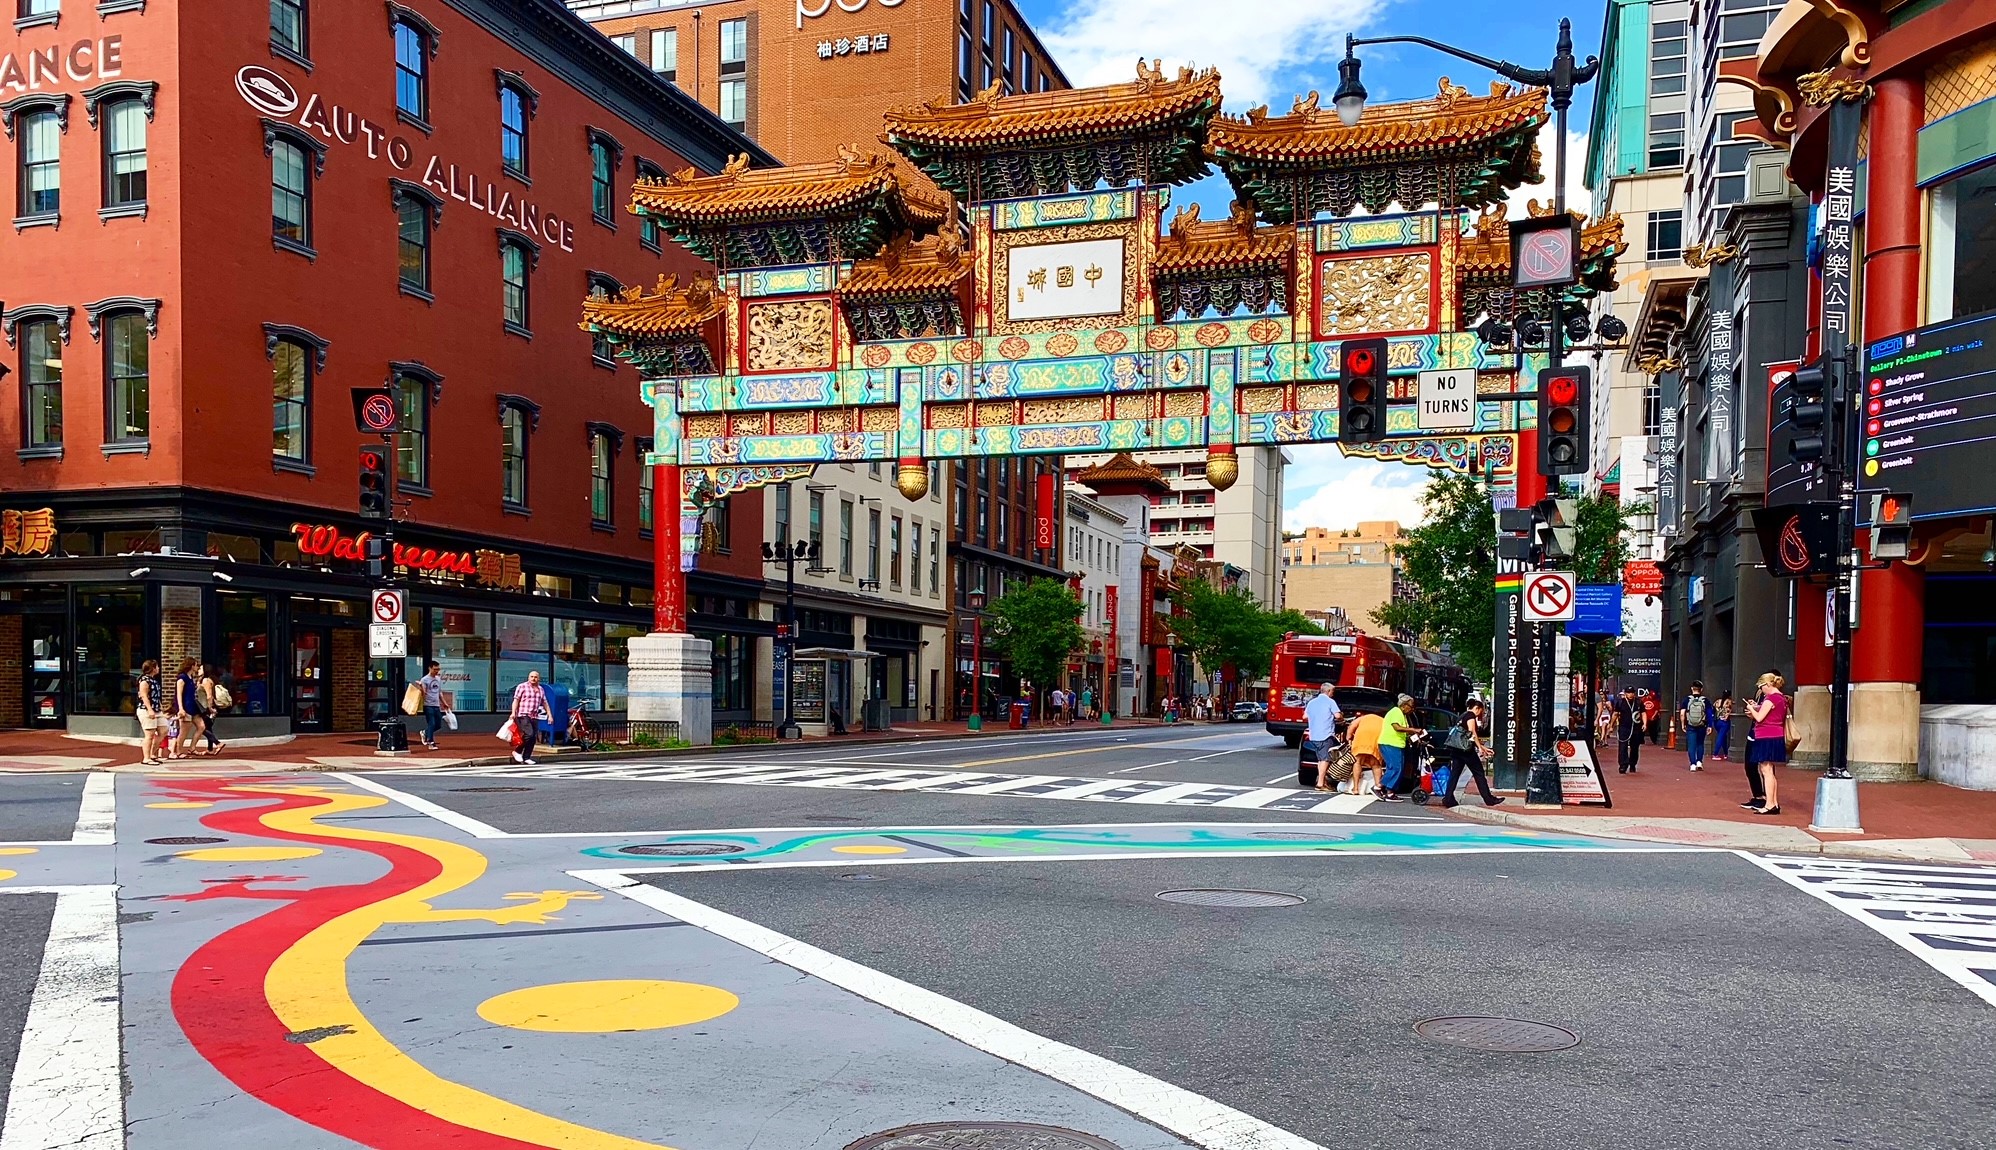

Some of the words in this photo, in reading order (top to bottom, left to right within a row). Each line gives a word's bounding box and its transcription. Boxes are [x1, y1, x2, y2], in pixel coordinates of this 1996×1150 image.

[816, 32, 889, 58] 袖珍酒店
[298, 93, 413, 170] AUTO
[422, 155, 575, 253] ALLIANCE
[1825, 166, 1854, 334] 美國娛樂公司
[1966, 339, 1984, 349] walk
[1710, 310, 1733, 432] 美國娛樂公司
[1885, 375, 1904, 387] Shady
[1904, 372, 1925, 383] Grove
[1437, 376, 1456, 390] NO
[1424, 398, 1469, 414] TURNS
[1884, 396, 1902, 408] Silver
[1902, 392, 1924, 405] Spring
[1883, 407, 1958, 428] Grosvenor-Strathmore
[1882, 436, 1914, 448] Greenbelt
[1881, 456, 1913, 469] Greenbelt
[1038, 517, 1049, 544] pod
[291, 522, 476, 574] Walreens
[1507, 594, 1518, 636] Gallery
[1507, 720, 1516, 761] Station
